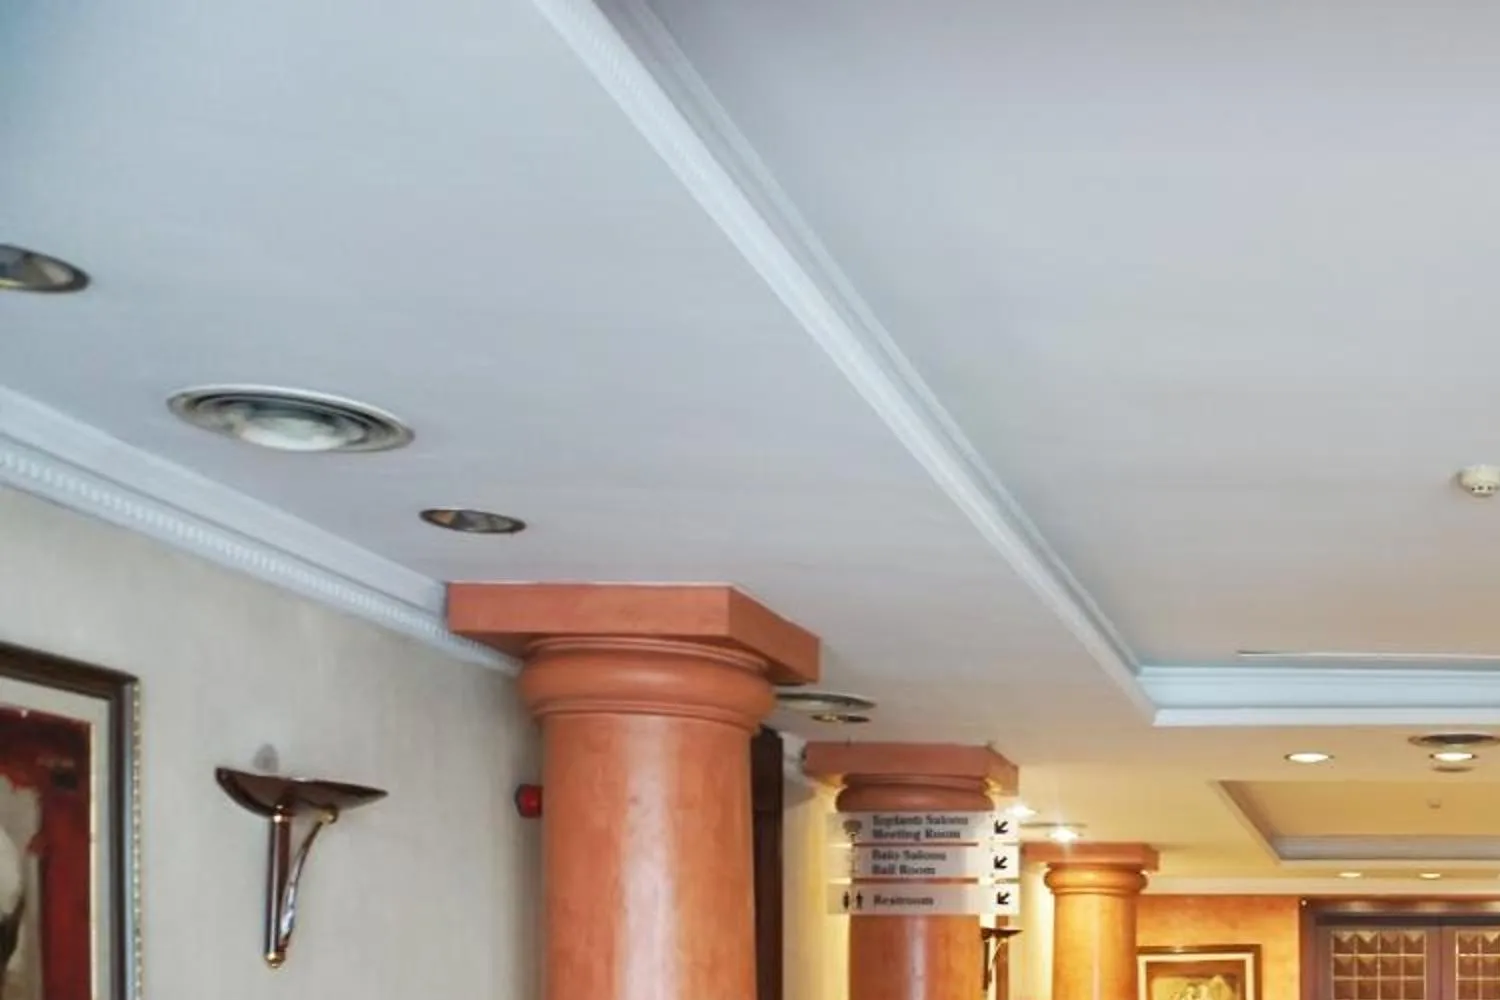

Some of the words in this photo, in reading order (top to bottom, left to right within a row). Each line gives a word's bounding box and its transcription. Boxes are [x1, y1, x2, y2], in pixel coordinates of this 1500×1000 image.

[872, 829, 921, 841] Meeting
[924, 829, 961, 839] Room
[871, 864, 896, 875] Ball
[899, 864, 936, 875] Room
[873, 894, 934, 905] Restroom
